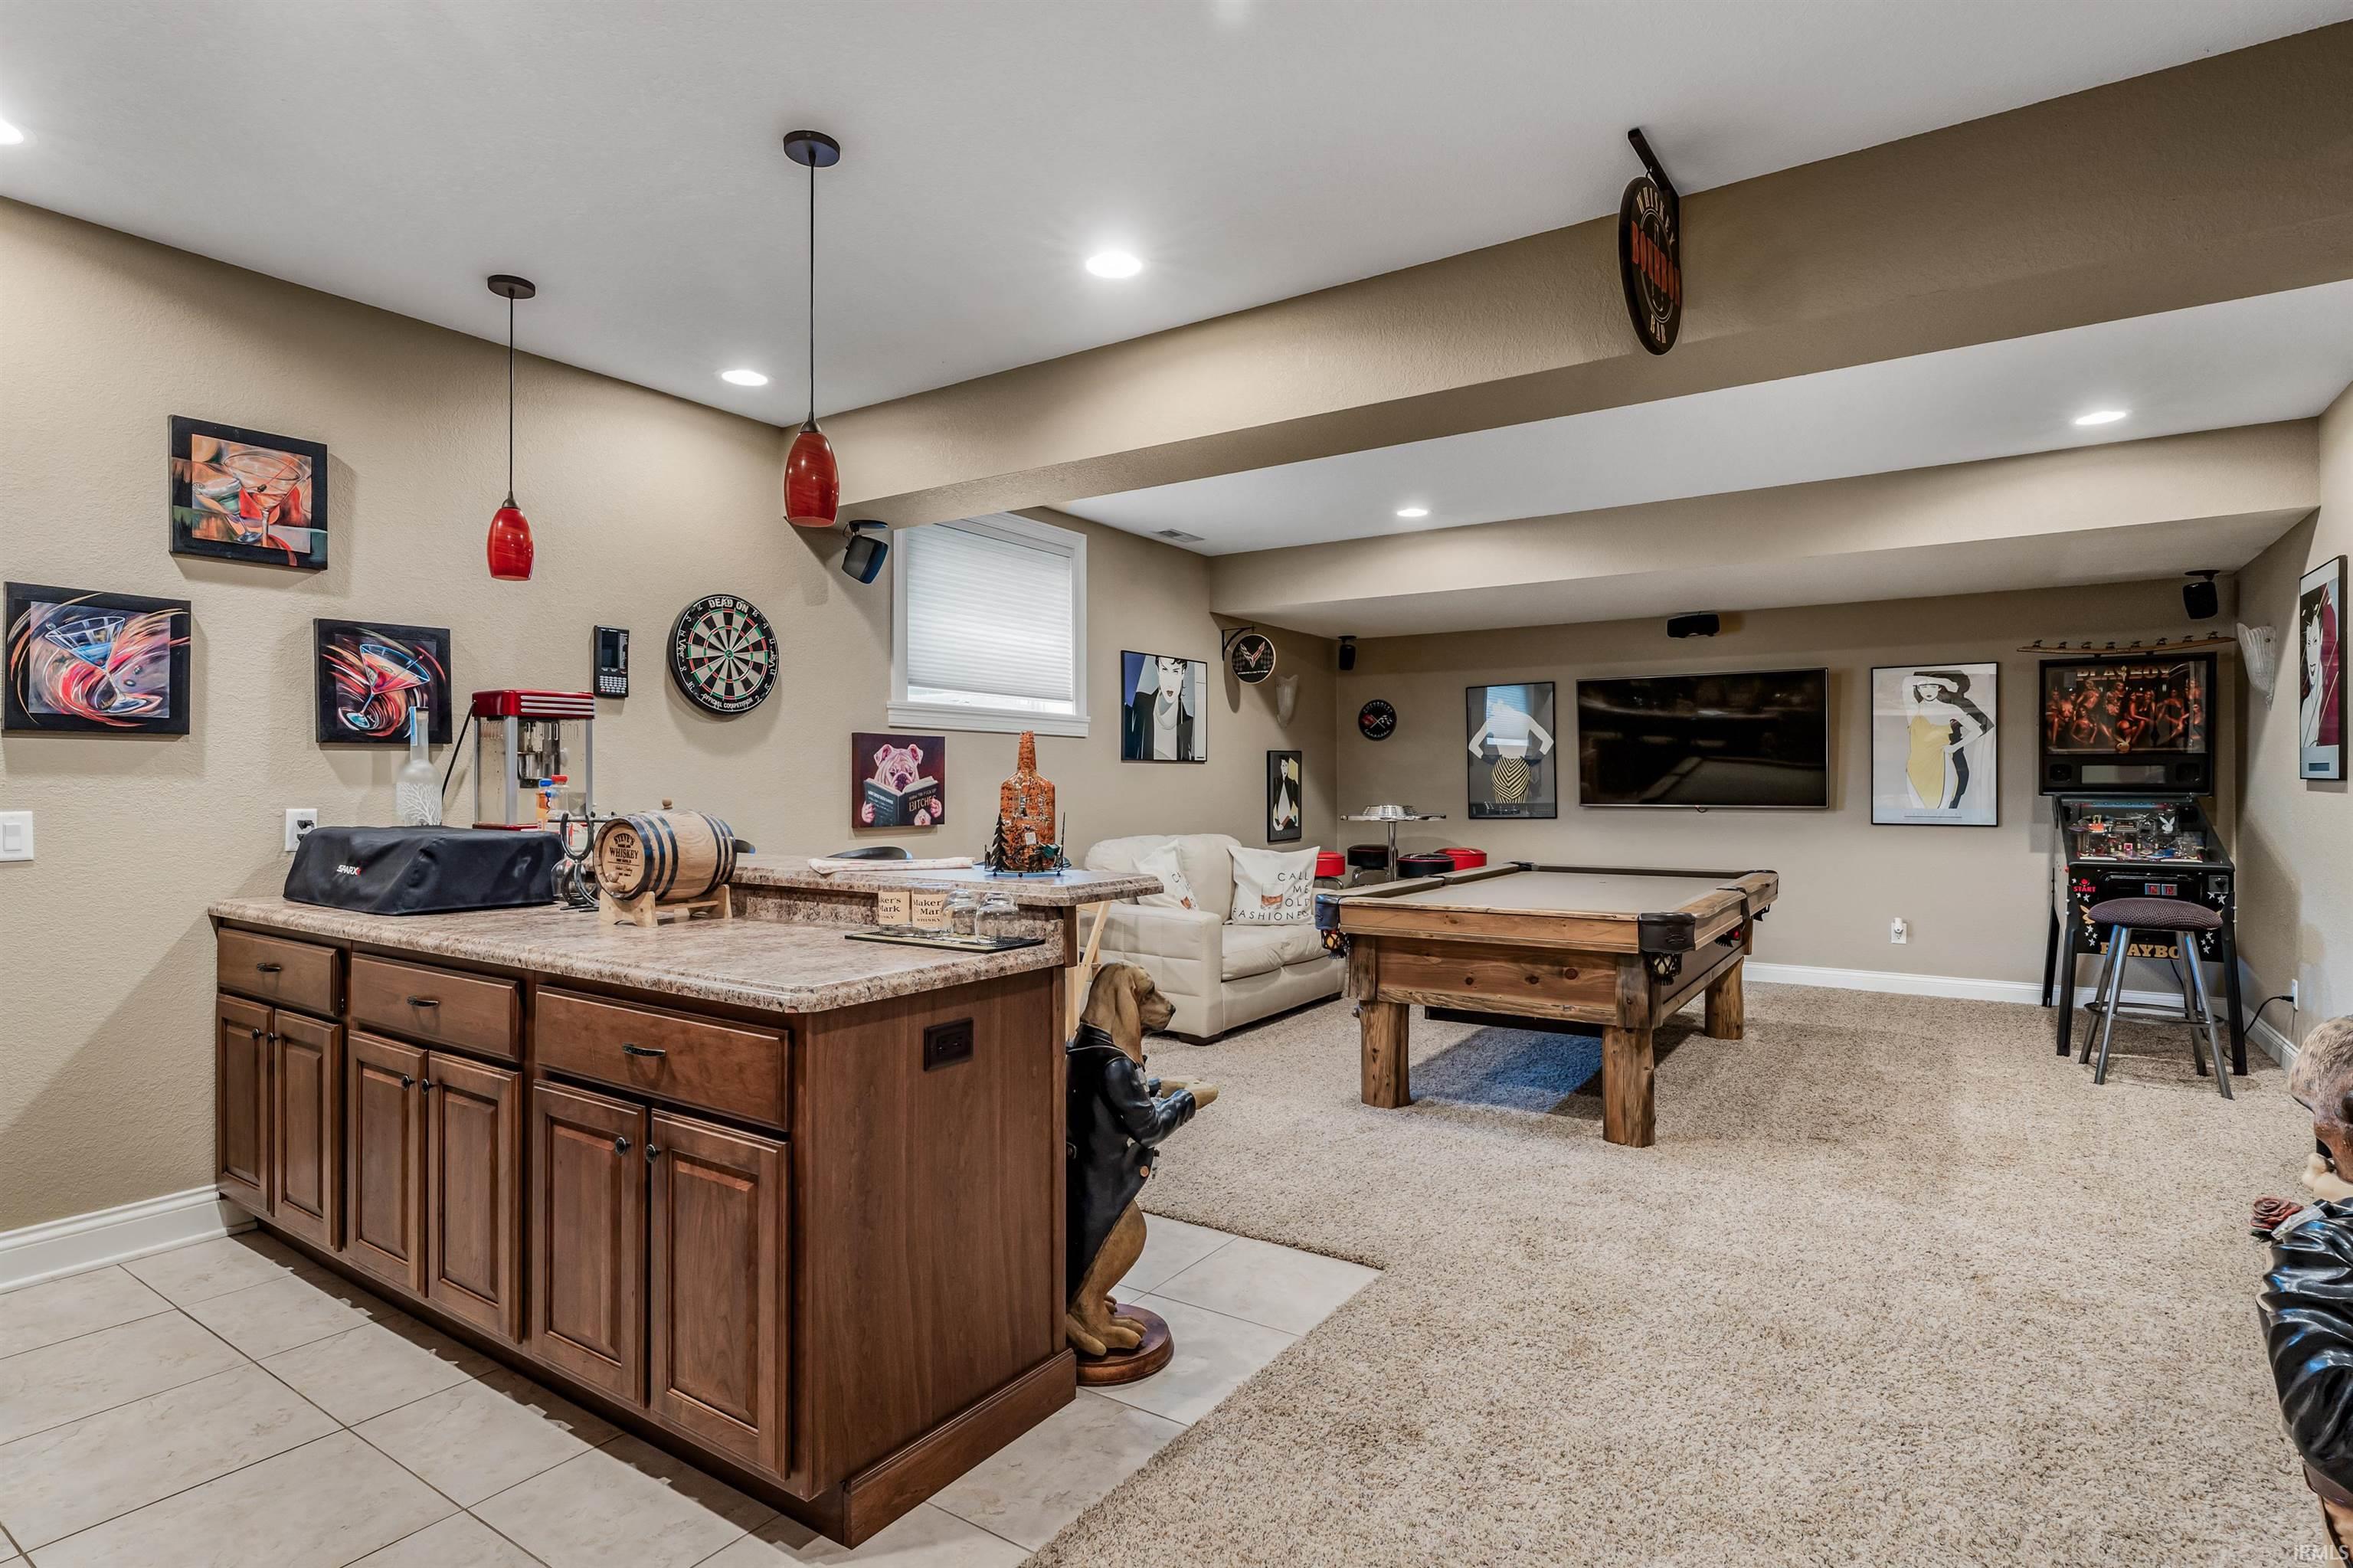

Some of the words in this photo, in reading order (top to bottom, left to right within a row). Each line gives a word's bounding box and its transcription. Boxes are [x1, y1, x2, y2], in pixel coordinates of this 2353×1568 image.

[1636, 186, 1675, 246] WHISKEY
[1631, 220, 1680, 307] BOURBON
[1650, 313, 1667, 344] BAR
[708, 597, 733, 608] DEAD
[735, 601, 749, 613] ON
[614, 833, 635, 846] STEVE'S
[610, 846, 639, 859] WHISKEY
[336, 864, 360, 876] SPARX
[1277, 871, 1310, 882] CALL
[1292, 885, 1309, 894] ME
